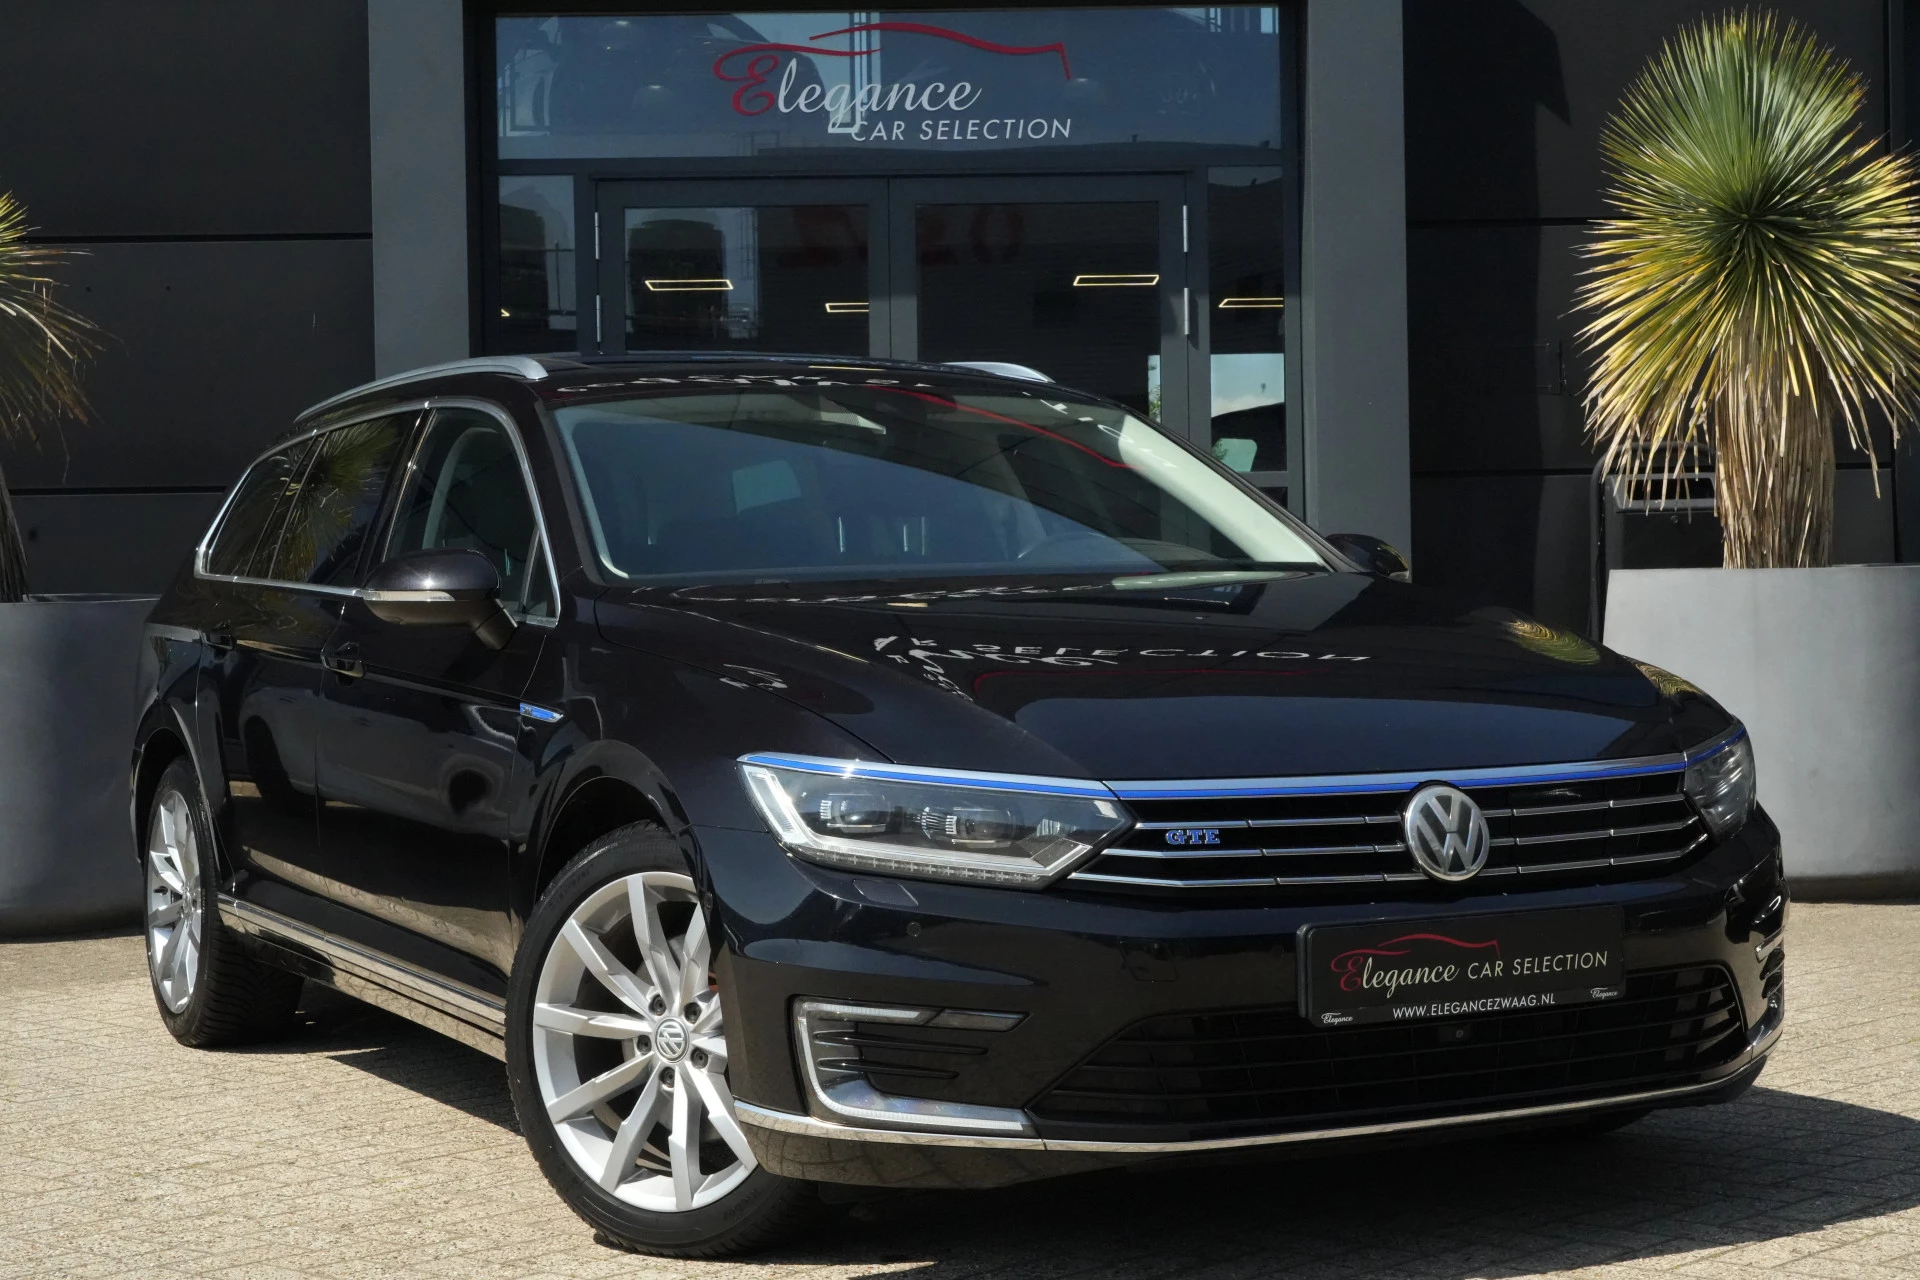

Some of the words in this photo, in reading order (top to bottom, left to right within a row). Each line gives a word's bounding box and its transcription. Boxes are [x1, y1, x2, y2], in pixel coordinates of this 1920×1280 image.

[713, 43, 982, 131] Elegance
[851, 119, 905, 141] CAR
[919, 118, 1071, 140] SELECTION
[1165, 829, 1221, 845] GTE
[1331, 949, 1459, 998] Elegance
[1467, 961, 1503, 979] CAR
[1512, 951, 1608, 976] SELECTION
[1590, 987, 1618, 999] Elegance
[1393, 993, 1556, 1019] WWW.ELEGANCEZWAAG.NL
[1321, 1012, 1353, 1025] Elegance
